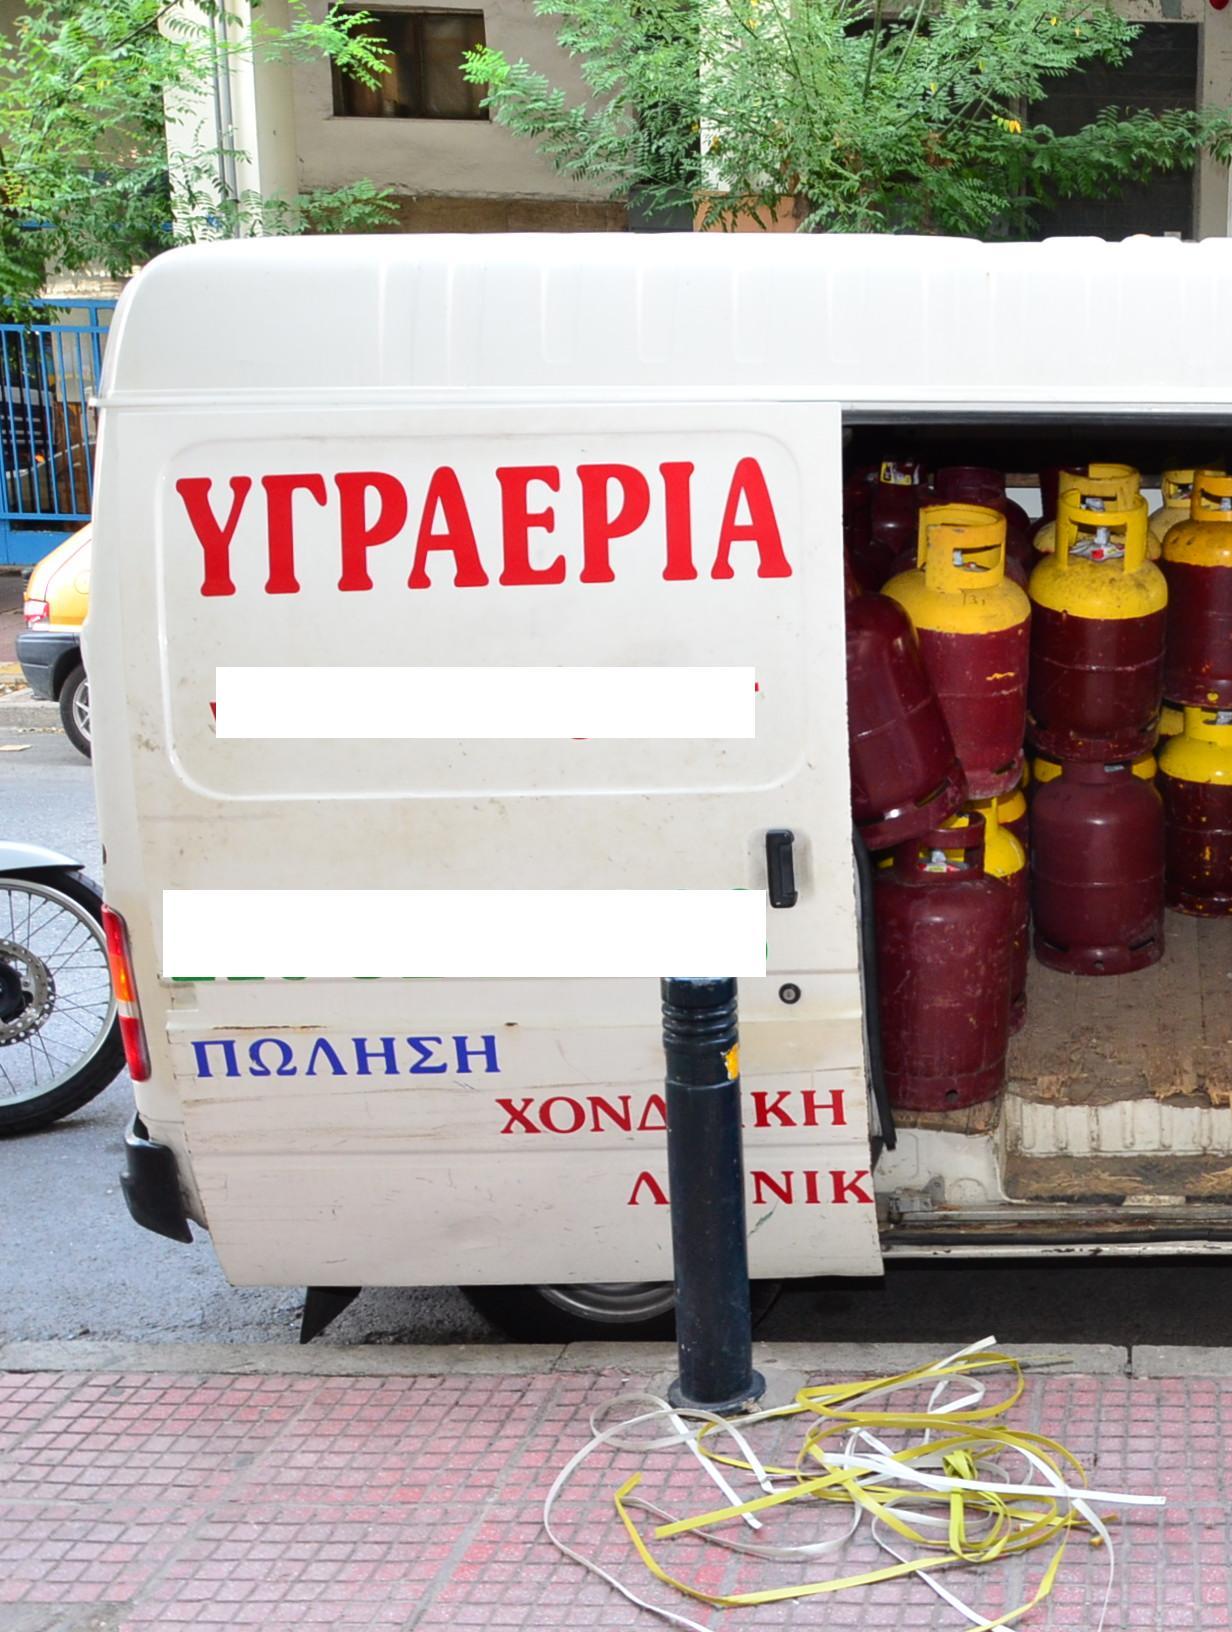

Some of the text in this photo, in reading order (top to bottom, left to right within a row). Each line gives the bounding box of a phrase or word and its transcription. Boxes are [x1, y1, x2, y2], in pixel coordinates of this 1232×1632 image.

[175, 457, 793, 597] ΥΓΡΑΕΡΙΑ
[192, 1035, 500, 1078] ΠΩΛΗΣΗ
[495, 1089, 848, 1135] ΧΟΝΔΚΗ
[627, 1170, 875, 1205] ΛΝΙΚ
